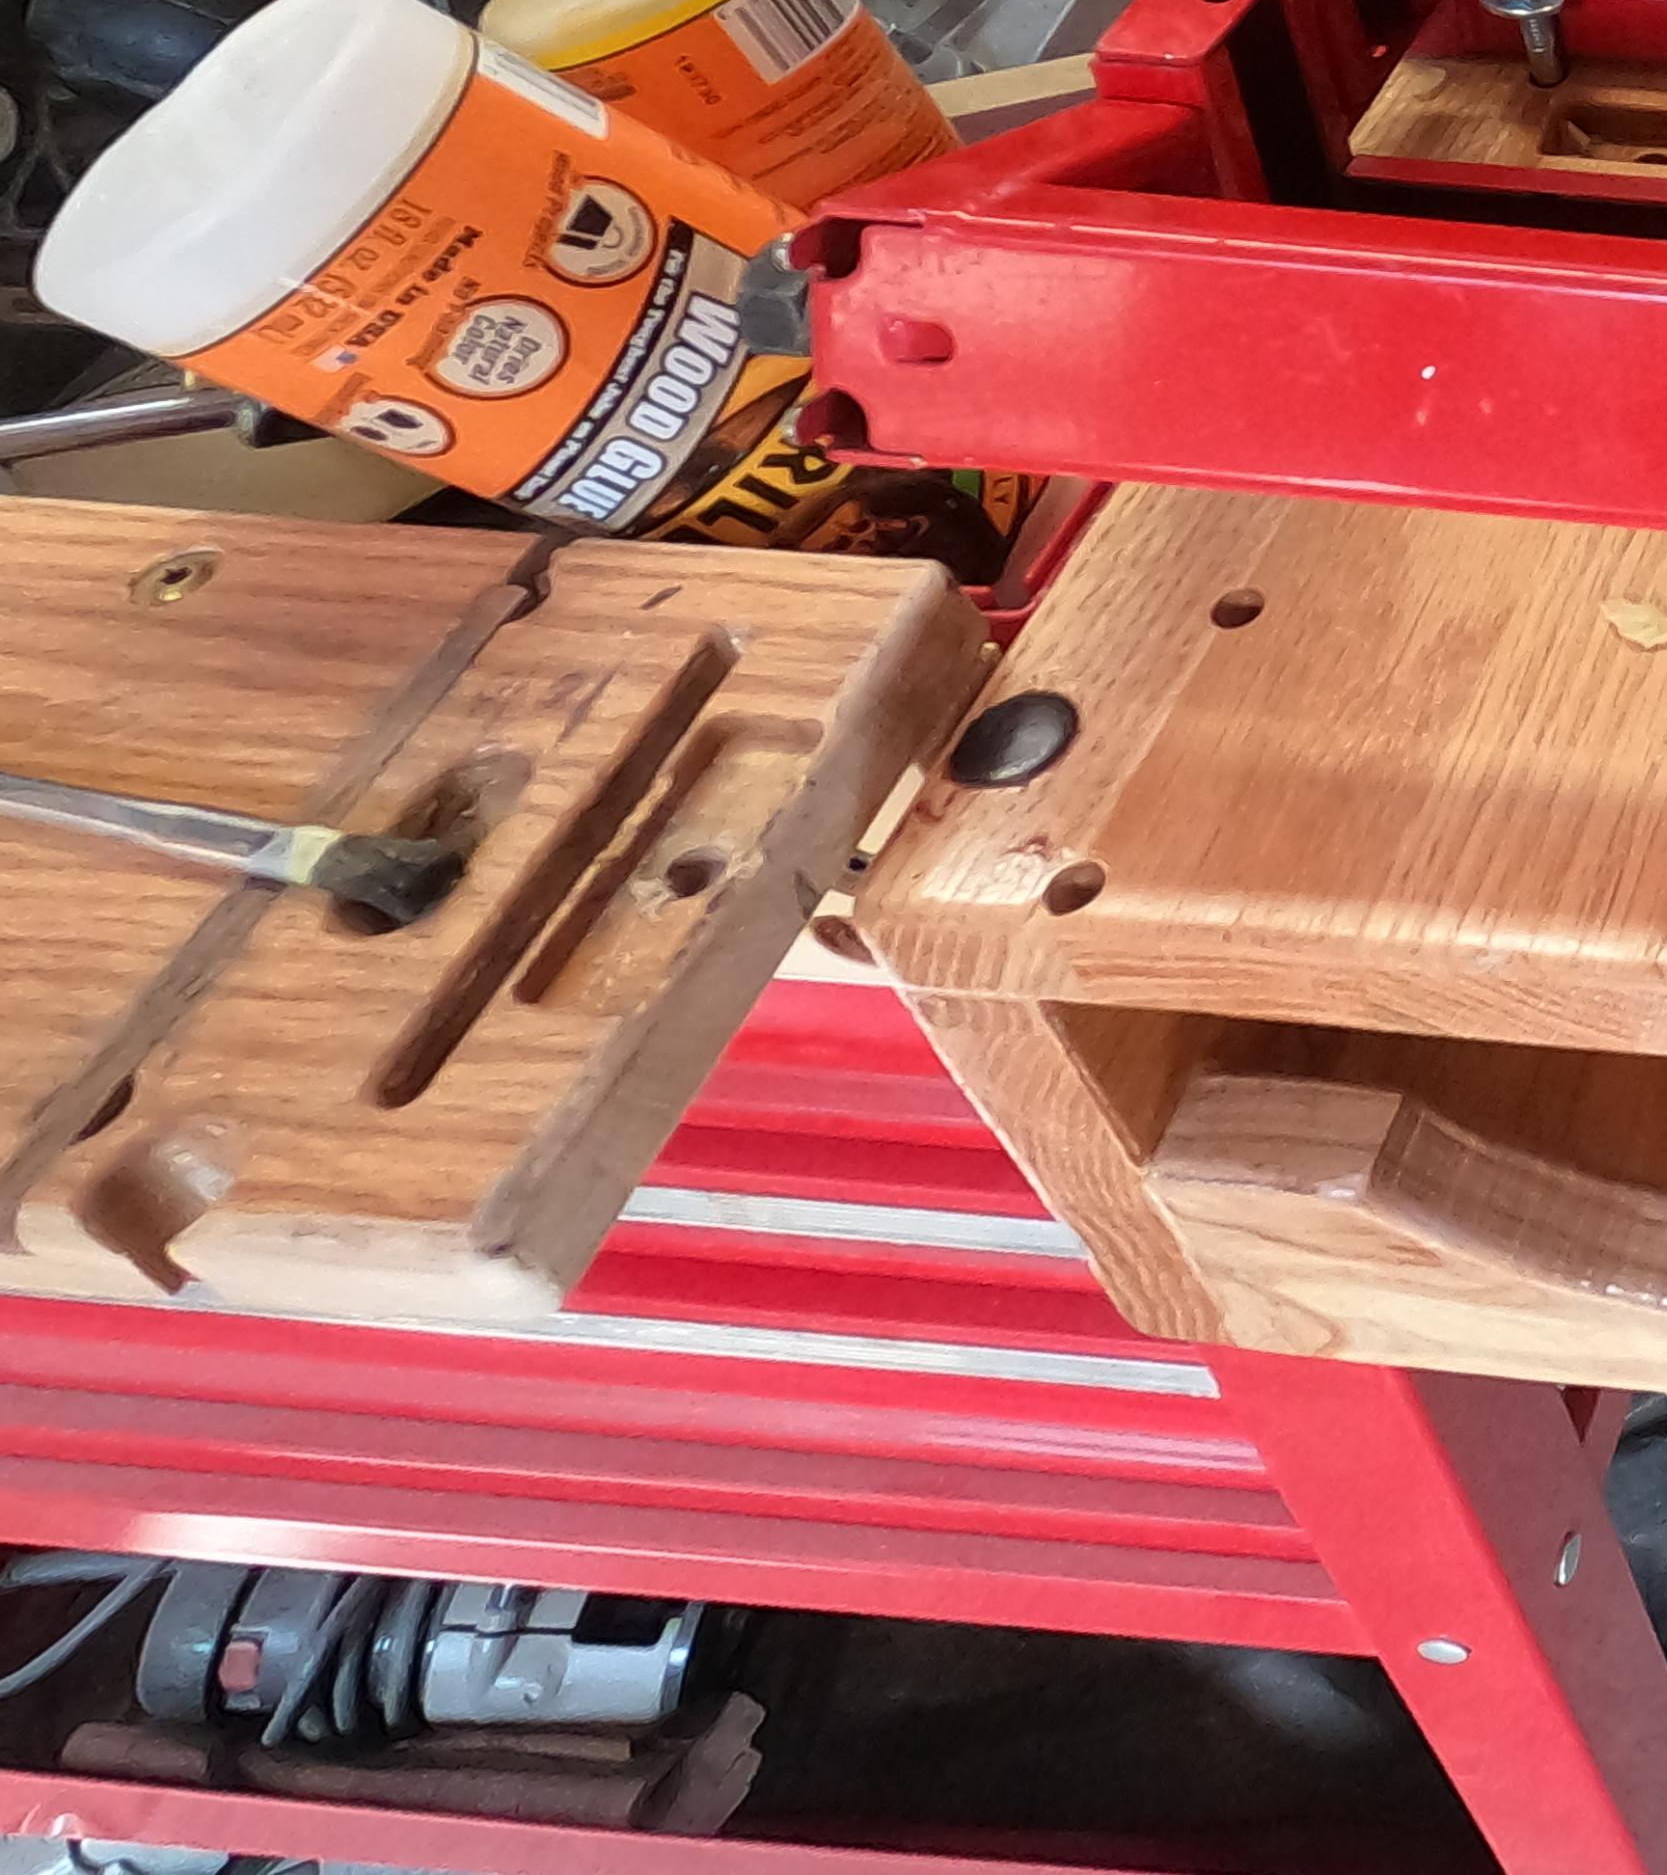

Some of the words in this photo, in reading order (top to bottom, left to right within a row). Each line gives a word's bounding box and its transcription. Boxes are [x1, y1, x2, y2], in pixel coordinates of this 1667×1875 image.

[452, 314, 497, 366] Color
[468, 315, 529, 386] Natural
[496, 335, 543, 385] Dries
[630, 295, 740, 440] WOOD
